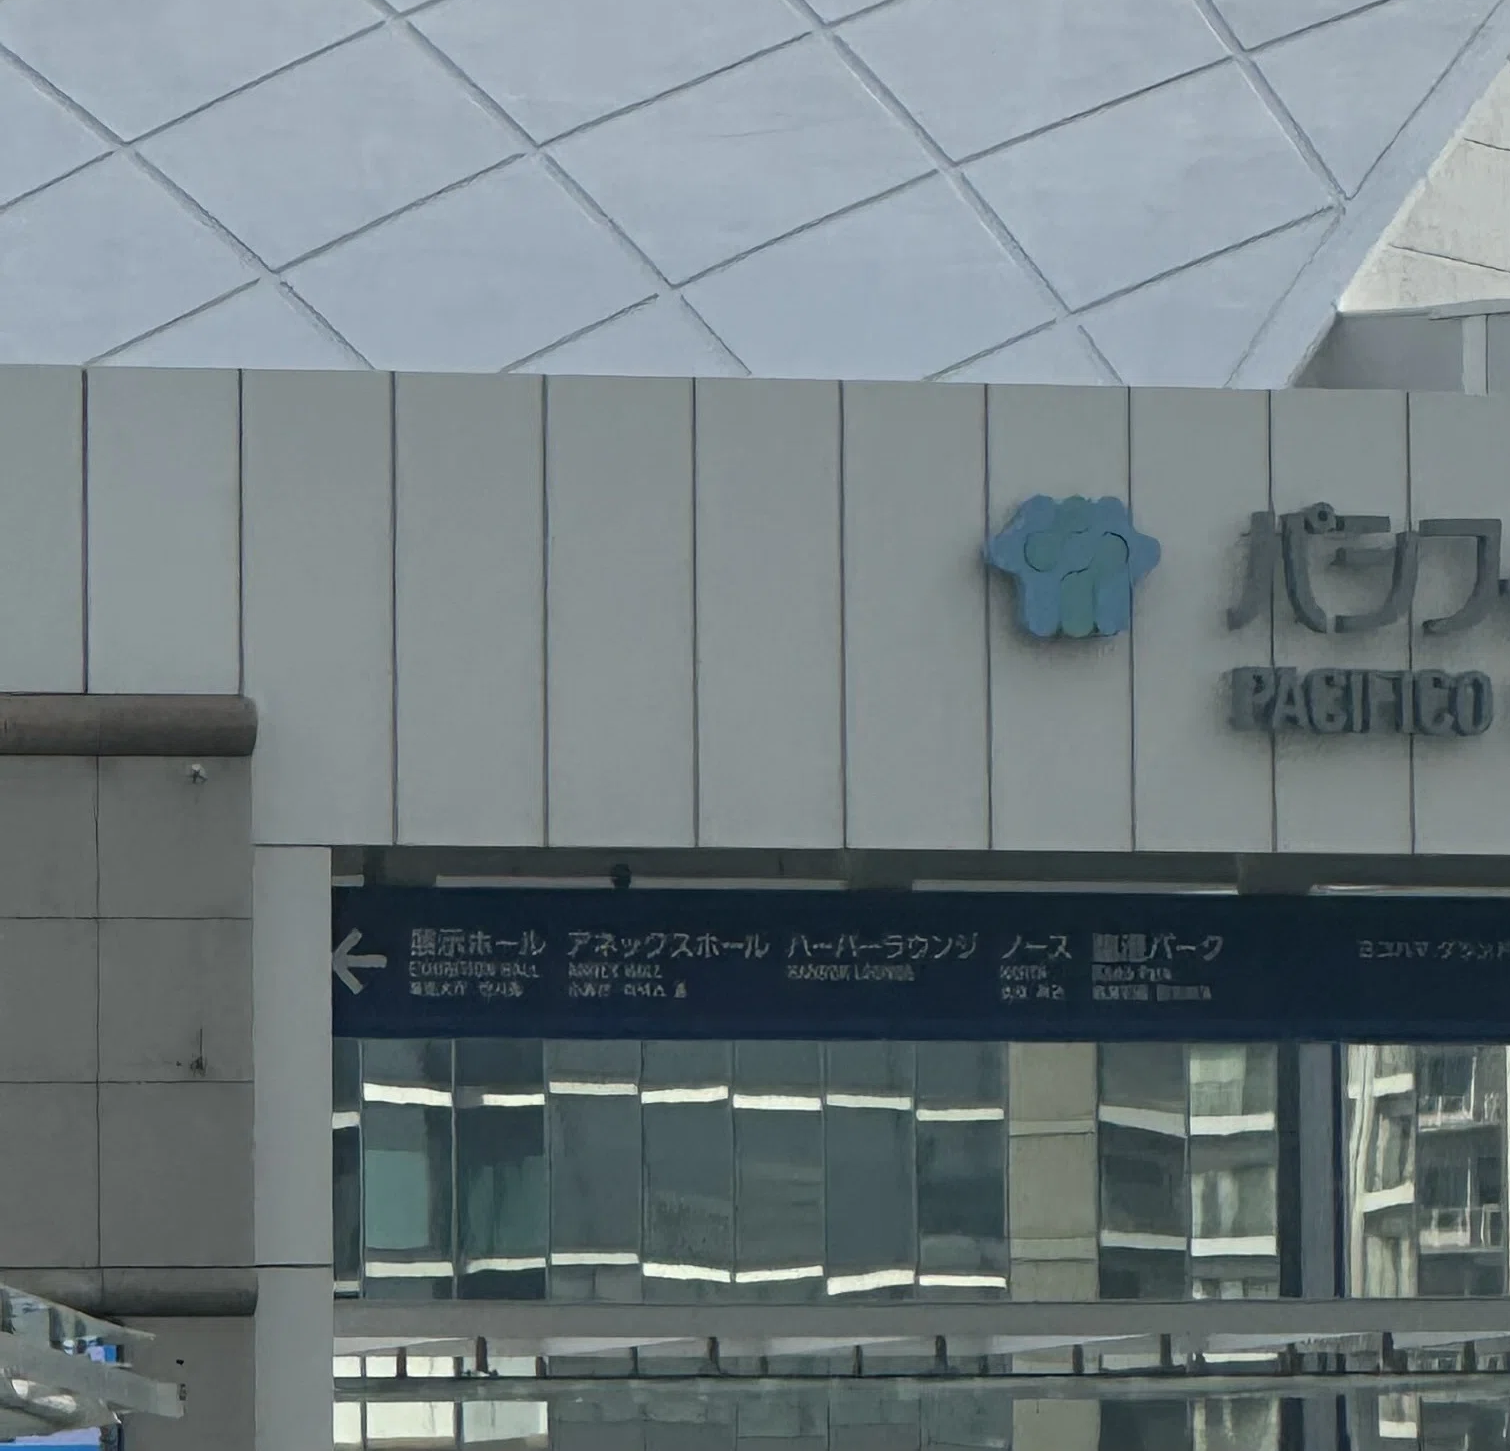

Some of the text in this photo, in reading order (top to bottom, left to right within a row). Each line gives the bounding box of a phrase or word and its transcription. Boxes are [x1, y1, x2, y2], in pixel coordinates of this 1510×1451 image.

[1228, 666, 1494, 736] PACIFICO
[567, 930, 771, 959] アネックスホール
